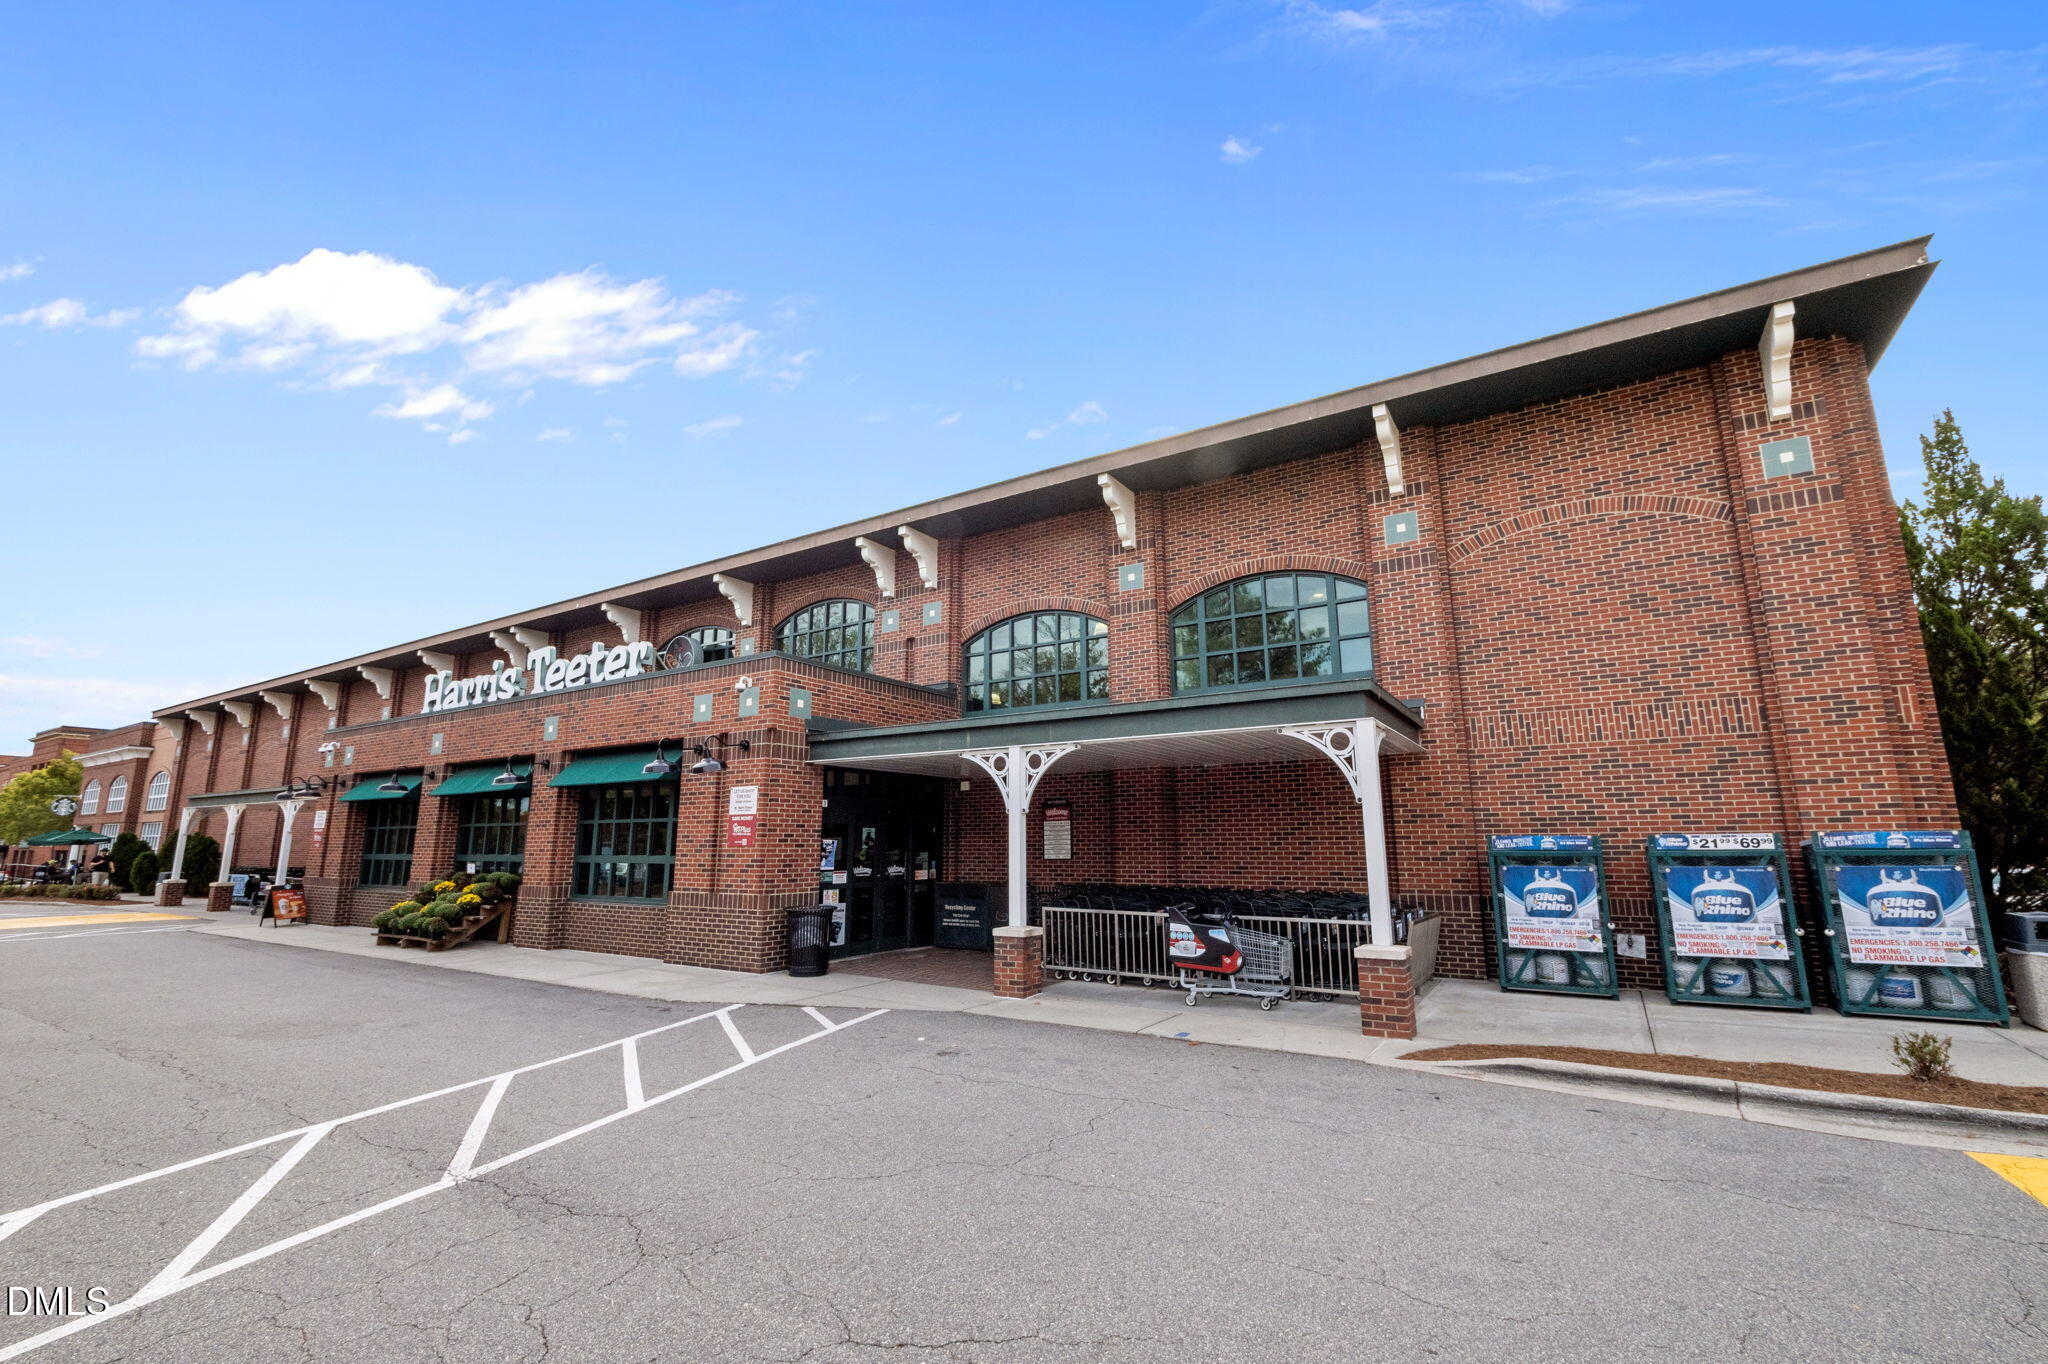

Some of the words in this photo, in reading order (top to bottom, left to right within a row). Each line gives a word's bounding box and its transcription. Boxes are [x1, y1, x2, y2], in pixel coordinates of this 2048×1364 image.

[420, 660, 522, 713] Harris
[527, 641, 653, 694] Teeter
[1046, 808, 1069, 816] Welcome
[853, 866, 872, 874] Welcome
[888, 865, 905, 873] Welcome
[1535, 893, 1566, 902] Blue
[1705, 895, 1742, 905] Blue
[1533, 902, 1572, 911] Rhino
[1883, 897, 1926, 908] Blue
[1703, 905, 1751, 915] Rhino
[1882, 907, 1937, 919] Rhino
